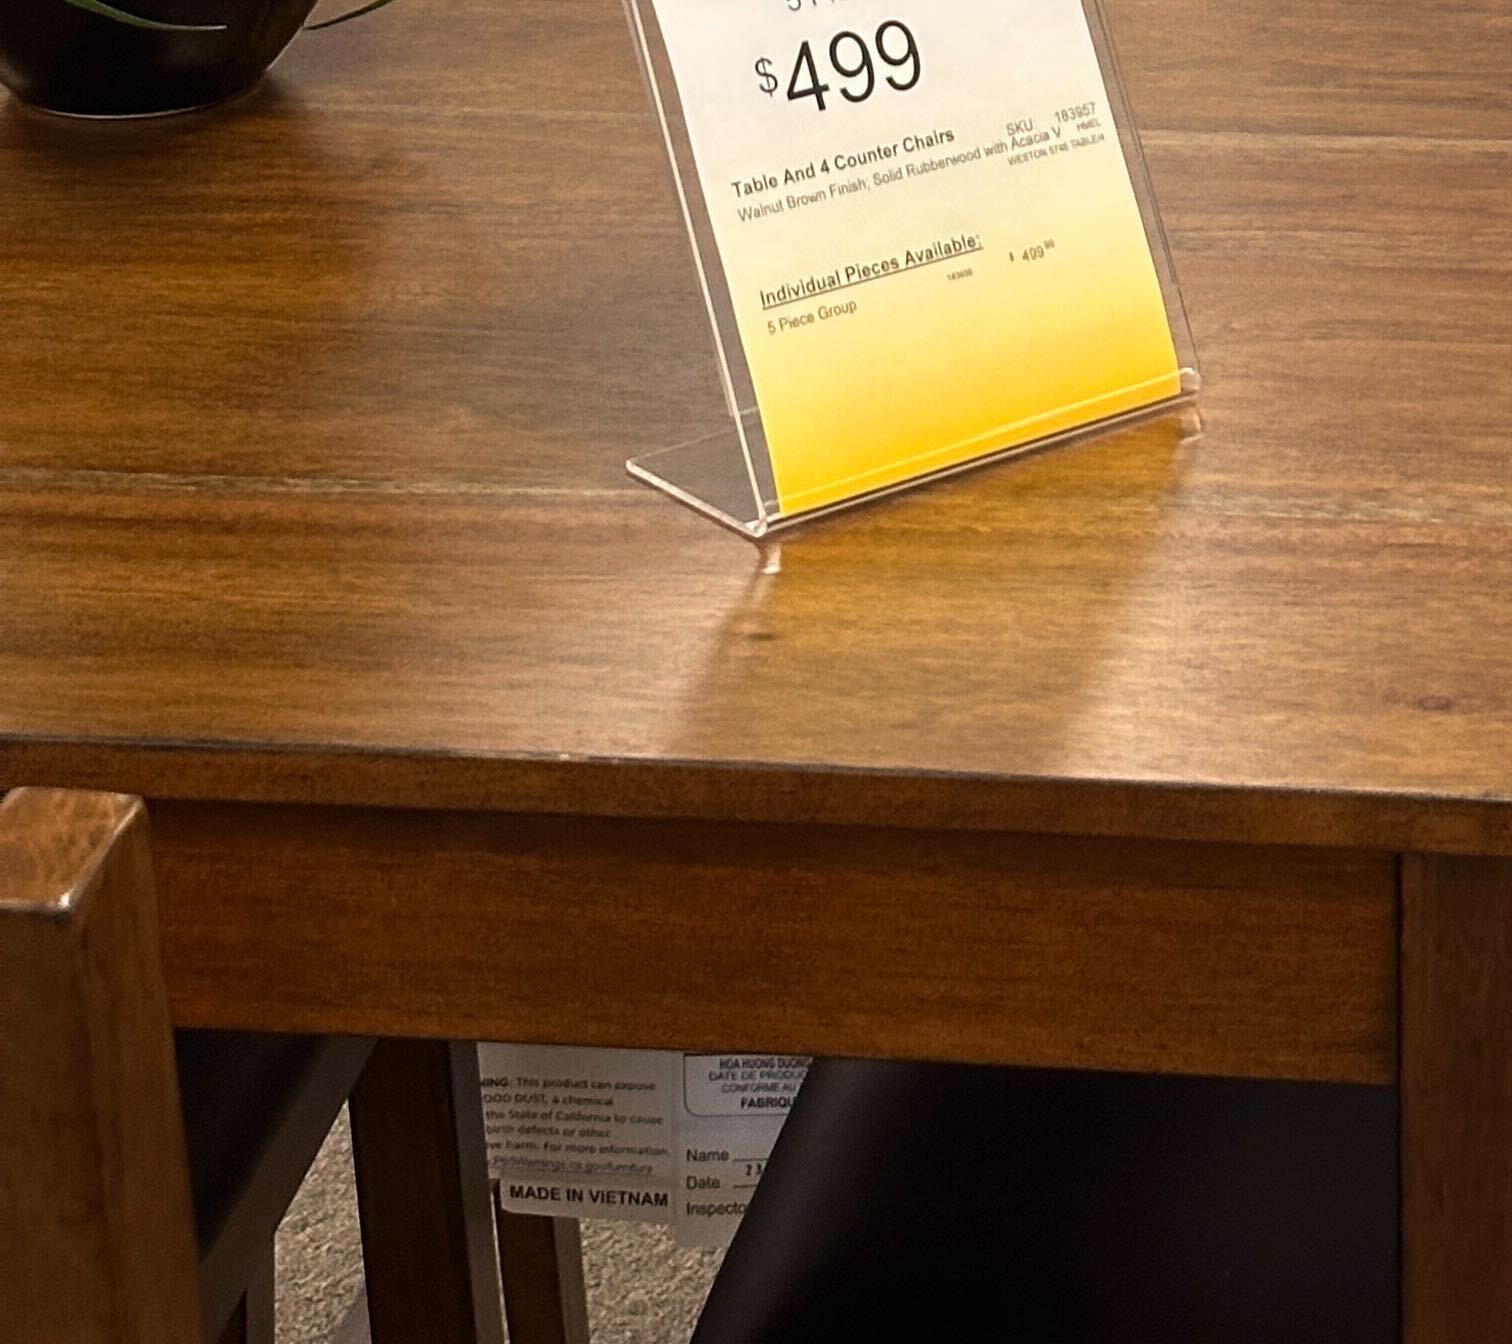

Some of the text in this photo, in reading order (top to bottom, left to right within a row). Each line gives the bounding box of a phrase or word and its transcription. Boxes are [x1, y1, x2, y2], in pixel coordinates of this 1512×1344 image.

[731, 127, 956, 199] Table And 4 Counter Chairs
[736, 199, 785, 223] Walnut
[786, 189, 828, 210] Brown
[872, 166, 903, 187] Solid
[904, 146, 982, 180] Rubberwood
[983, 140, 1009, 158] with
[1010, 129, 1051, 151] Acacia
[759, 269, 841, 309] Individual
[844, 252, 900, 287] Pieces
[766, 298, 858, 336] 5 Piece Group
[555, 1110, 612, 1124] California
[686, 1147, 731, 1163] Name
[510, 1184, 669, 1208] MADE IN VIETNAM
[686, 1175, 721, 1190] Date
